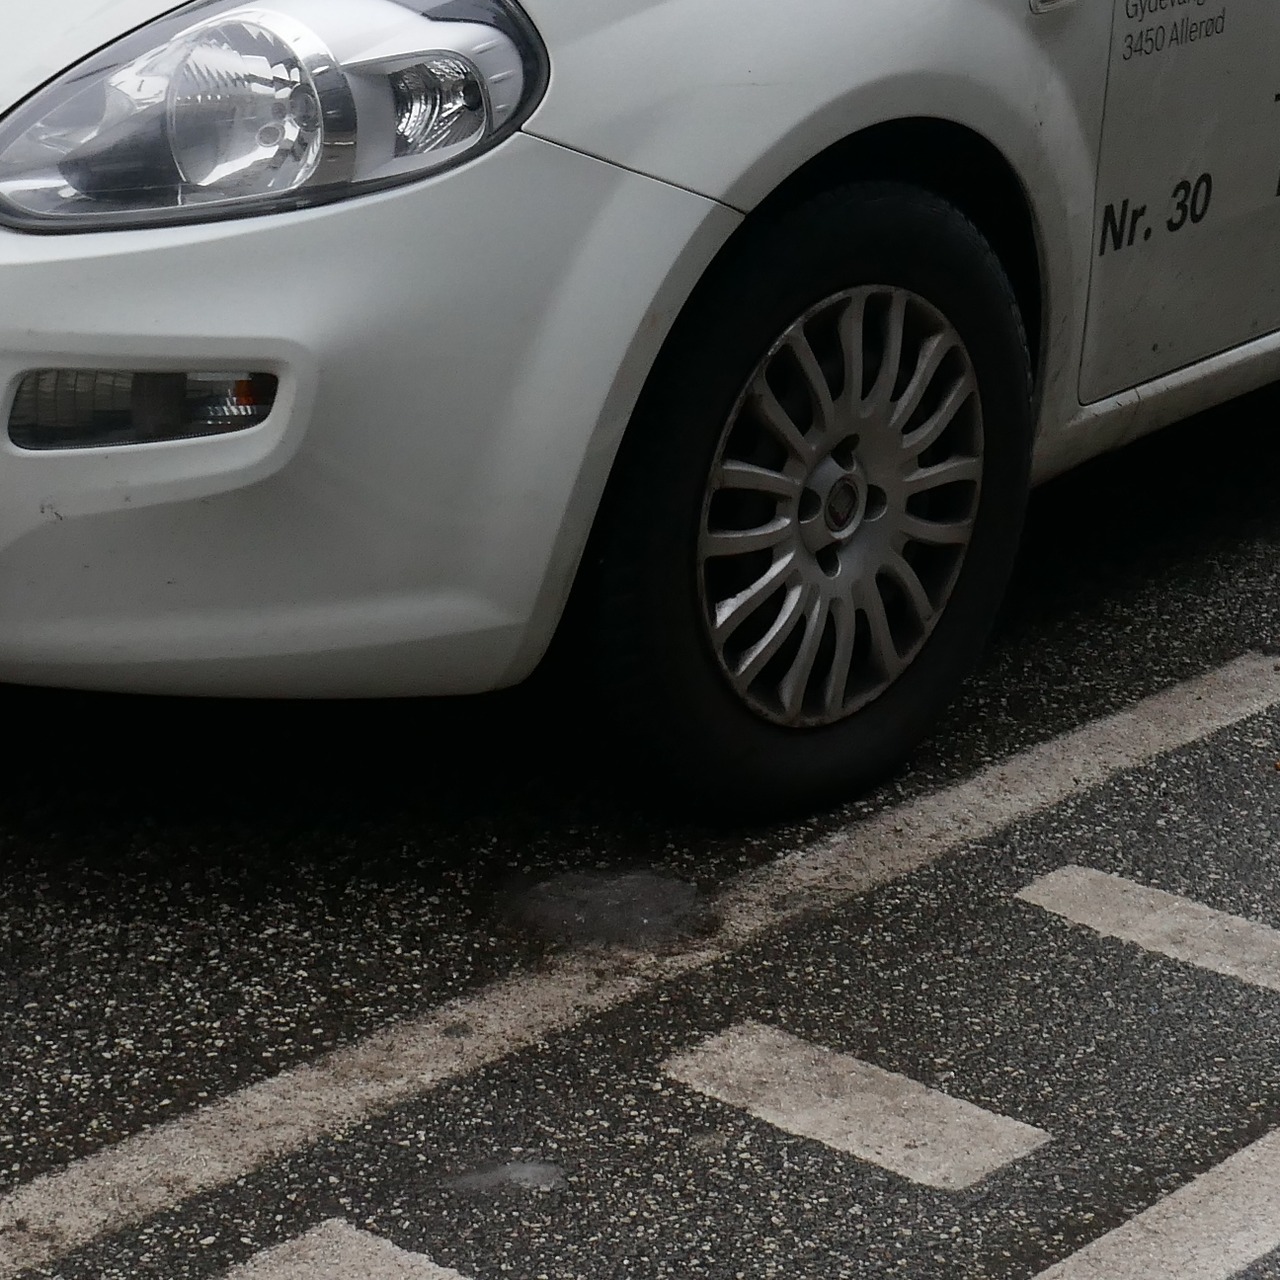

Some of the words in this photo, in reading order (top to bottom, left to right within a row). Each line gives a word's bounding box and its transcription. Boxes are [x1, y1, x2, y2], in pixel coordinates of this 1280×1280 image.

[1122, 25, 1166, 61] 3450
[1170, 7, 1225, 47] Allerød
[1099, 198, 1152, 256] Nr.
[1166, 173, 1212, 232] 30
